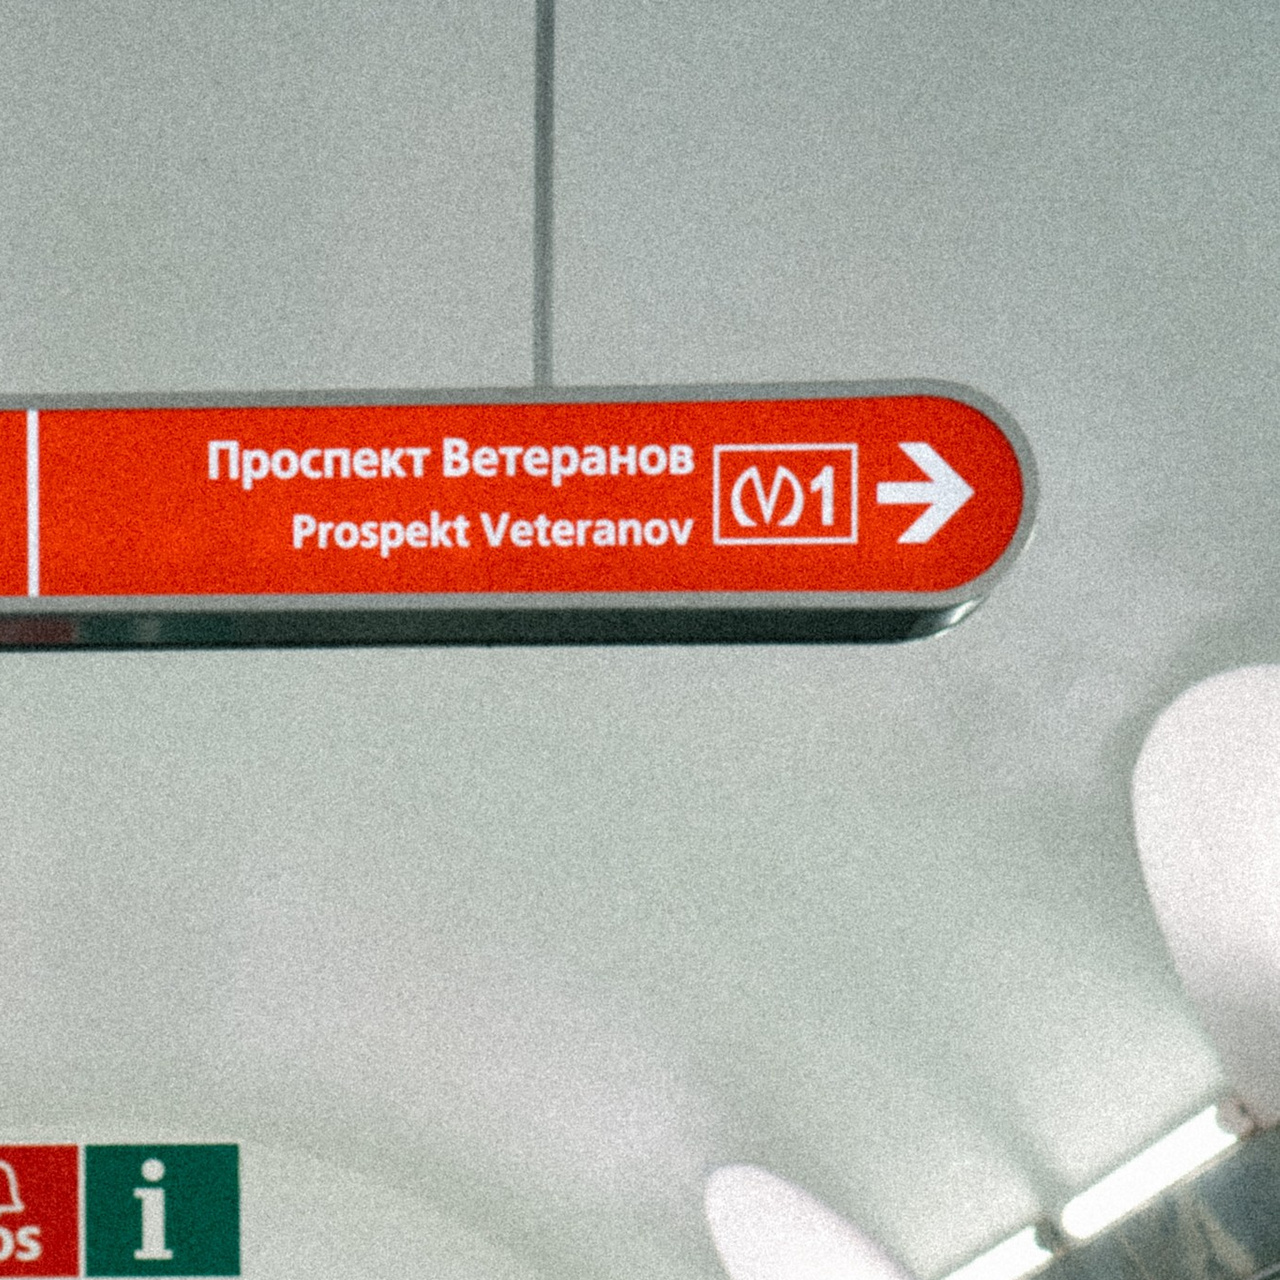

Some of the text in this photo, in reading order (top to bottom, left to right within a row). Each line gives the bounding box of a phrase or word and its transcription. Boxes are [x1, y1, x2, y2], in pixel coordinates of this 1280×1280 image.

[207, 436, 696, 491] Проспект Ветеранов
[291, 509, 695, 559] Prospekt Veteranov
